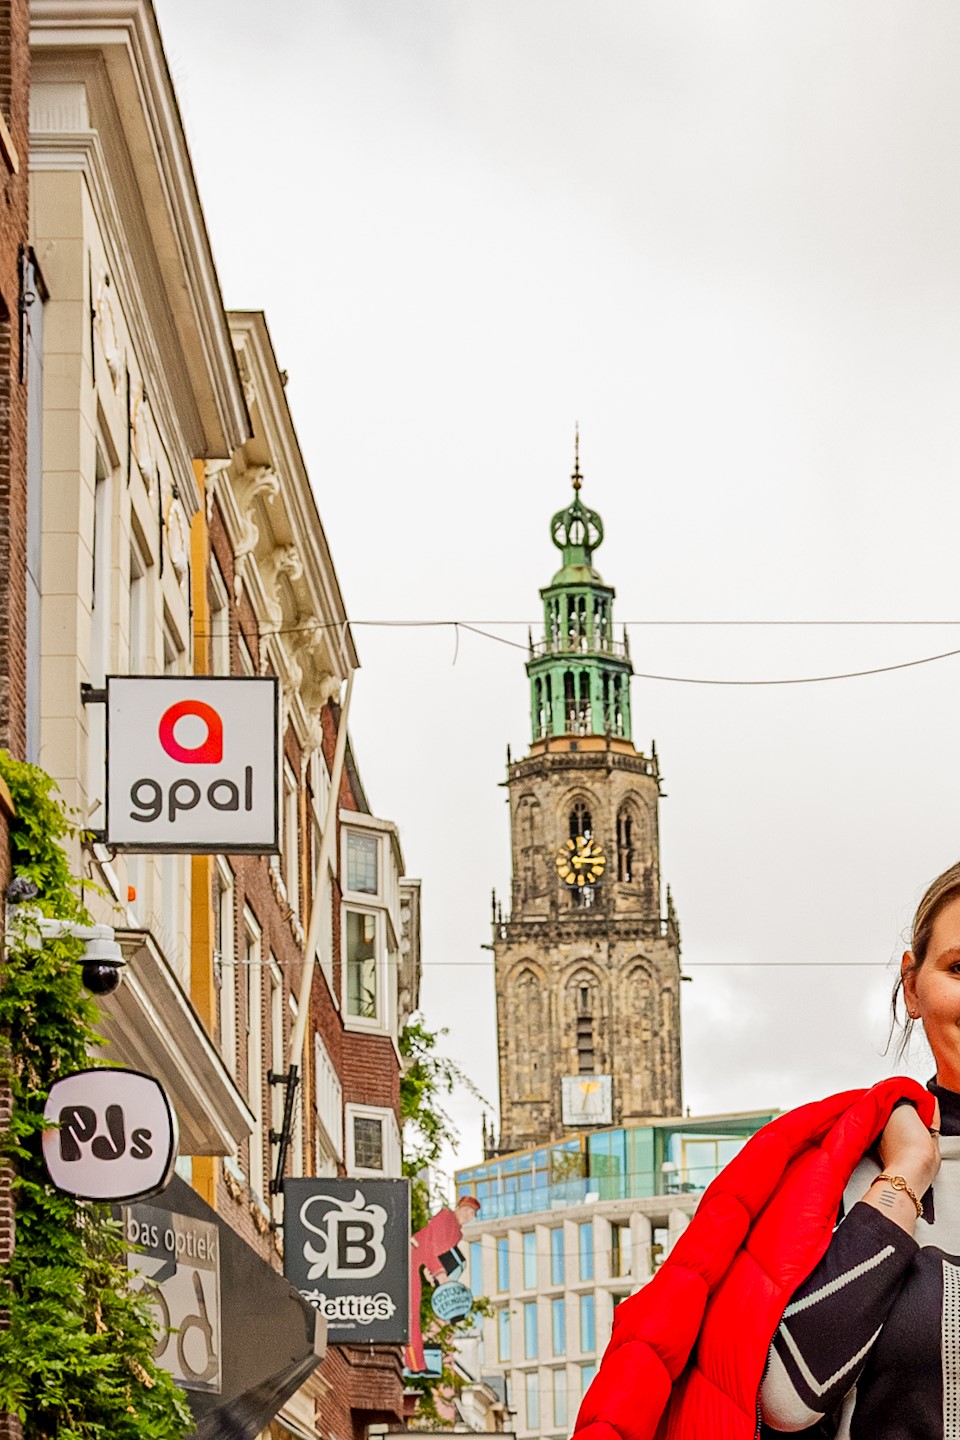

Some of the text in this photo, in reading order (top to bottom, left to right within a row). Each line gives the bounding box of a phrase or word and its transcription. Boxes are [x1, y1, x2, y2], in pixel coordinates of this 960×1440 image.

[130, 765, 253, 823] gpal
[59, 1104, 153, 1162] PJs
[164, 1227, 217, 1262] optiek
[336, 1220, 376, 1270] B
